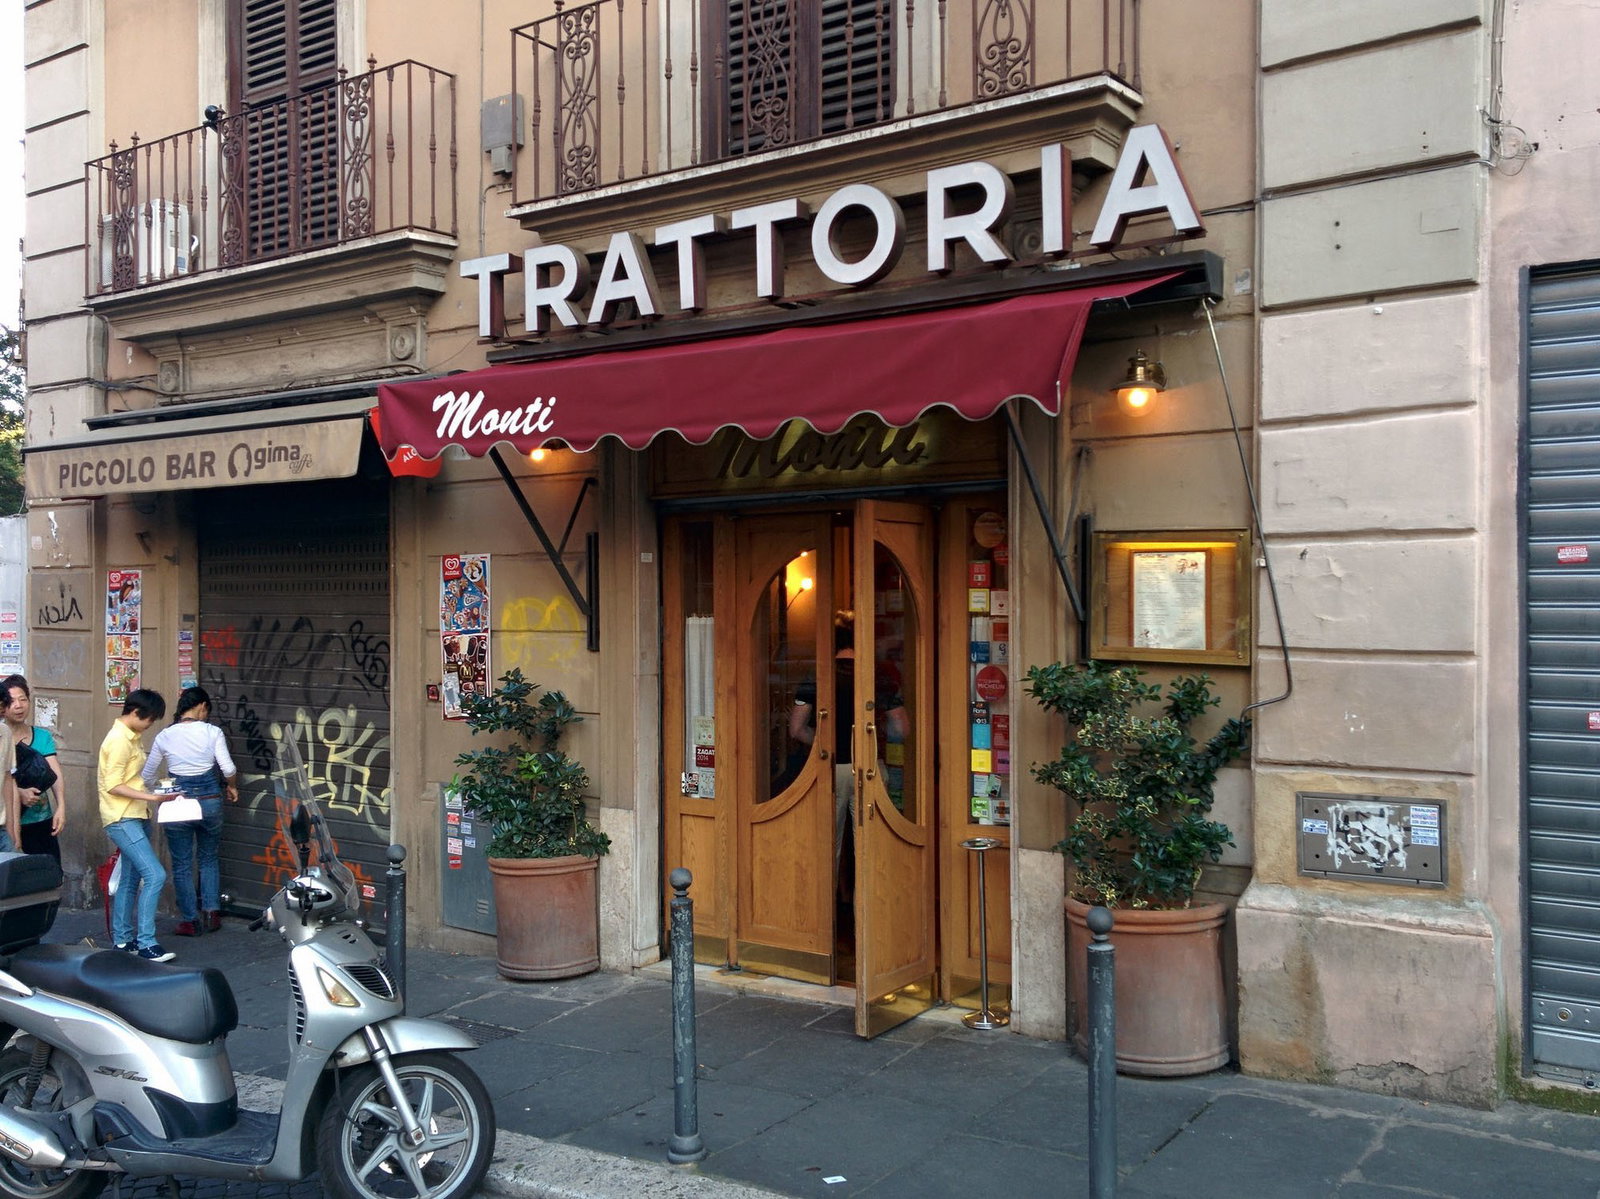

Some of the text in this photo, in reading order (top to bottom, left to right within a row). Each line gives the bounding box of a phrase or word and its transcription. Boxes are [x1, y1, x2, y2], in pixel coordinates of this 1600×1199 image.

[460, 124, 1204, 340] TRATTORIA
[432, 390, 556, 439] Monti
[59, 440, 301, 489] PICCOLO BAR gima
